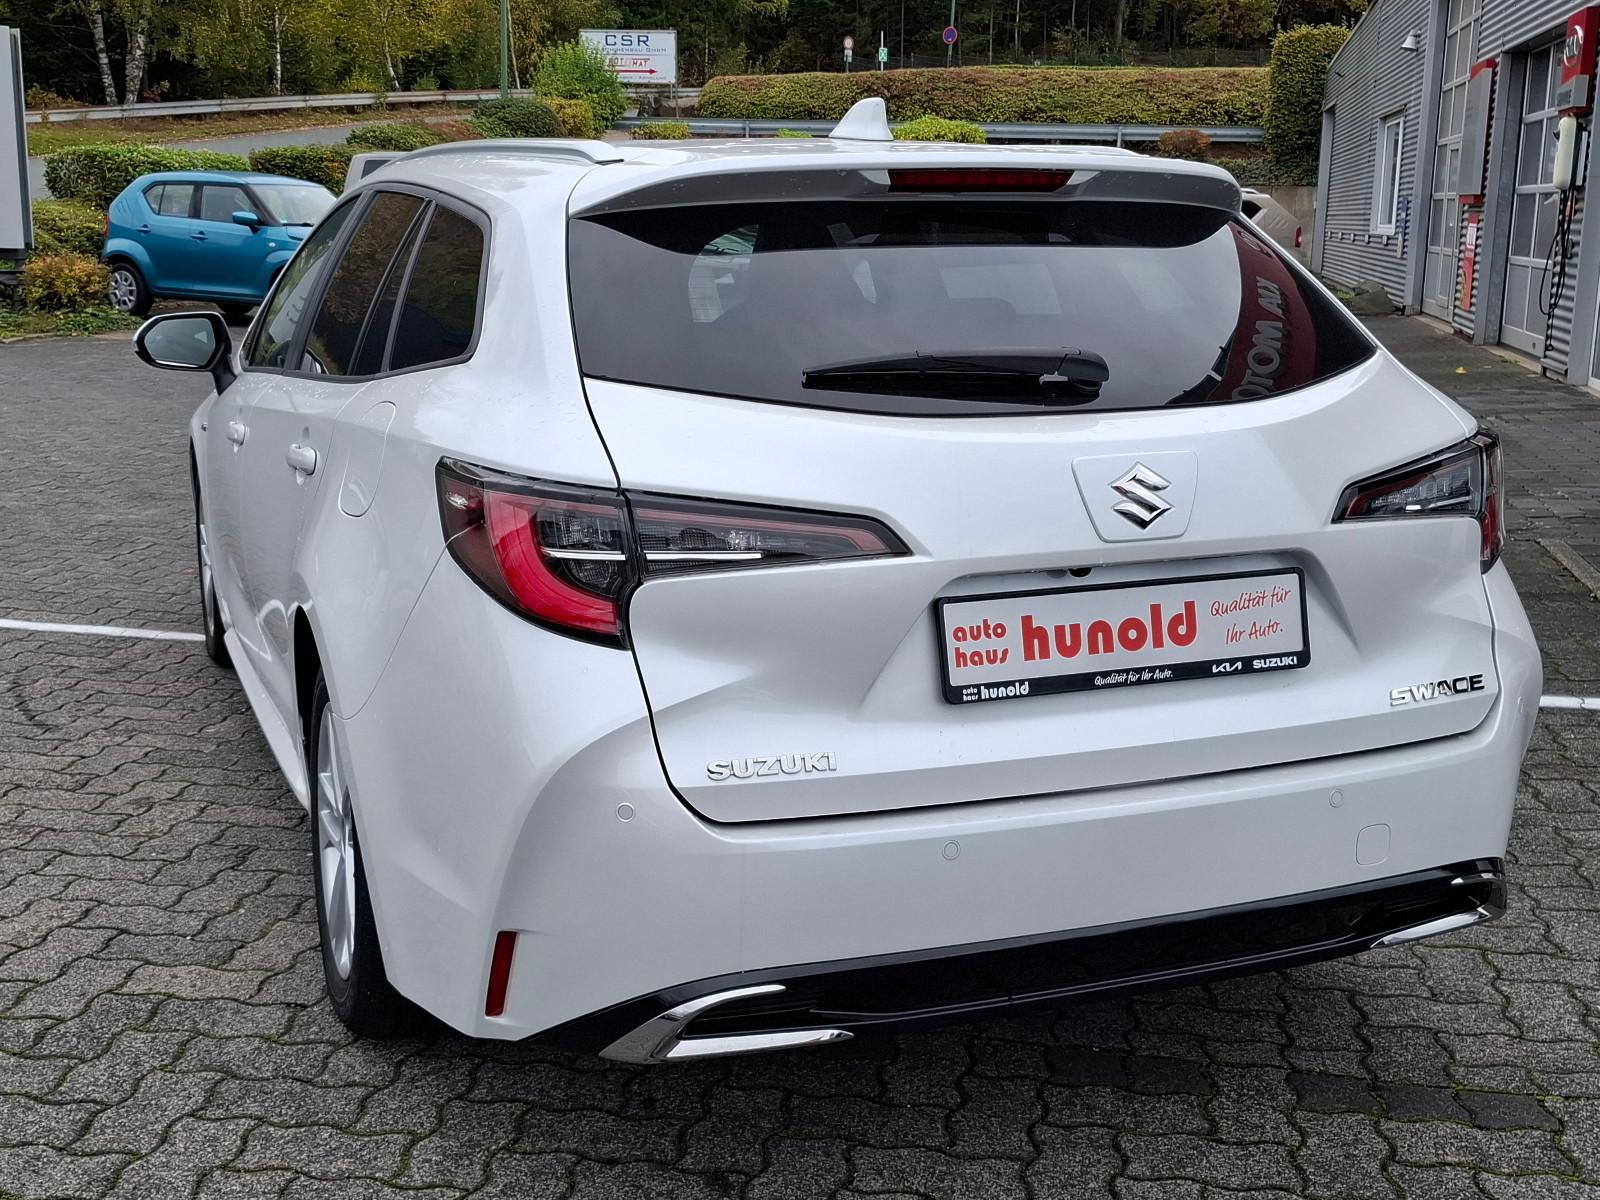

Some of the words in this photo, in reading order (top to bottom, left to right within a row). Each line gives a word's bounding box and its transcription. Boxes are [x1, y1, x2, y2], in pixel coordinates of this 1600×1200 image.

[605, 34, 649, 47] CSR
[1211, 590, 1268, 617] Qualität
[1270, 585, 1291, 608] für
[952, 618, 1007, 643] auto
[1020, 600, 1197, 662] hunold
[1226, 623, 1246, 645] Ihr
[1248, 618, 1283, 640] Auto.
[954, 646, 1009, 668] haus
[1252, 656, 1298, 669] SUZUKI
[1094, 672, 1127, 686] Qualität
[1127, 671, 1140, 684] für
[1140, 668, 1153, 681] Ihr
[962, 686, 978, 695] auto
[963, 694, 979, 702] haus
[980, 680, 1029, 700] hunold
[1390, 673, 1486, 707] SWACE
[707, 751, 838, 781] SUZUKI
